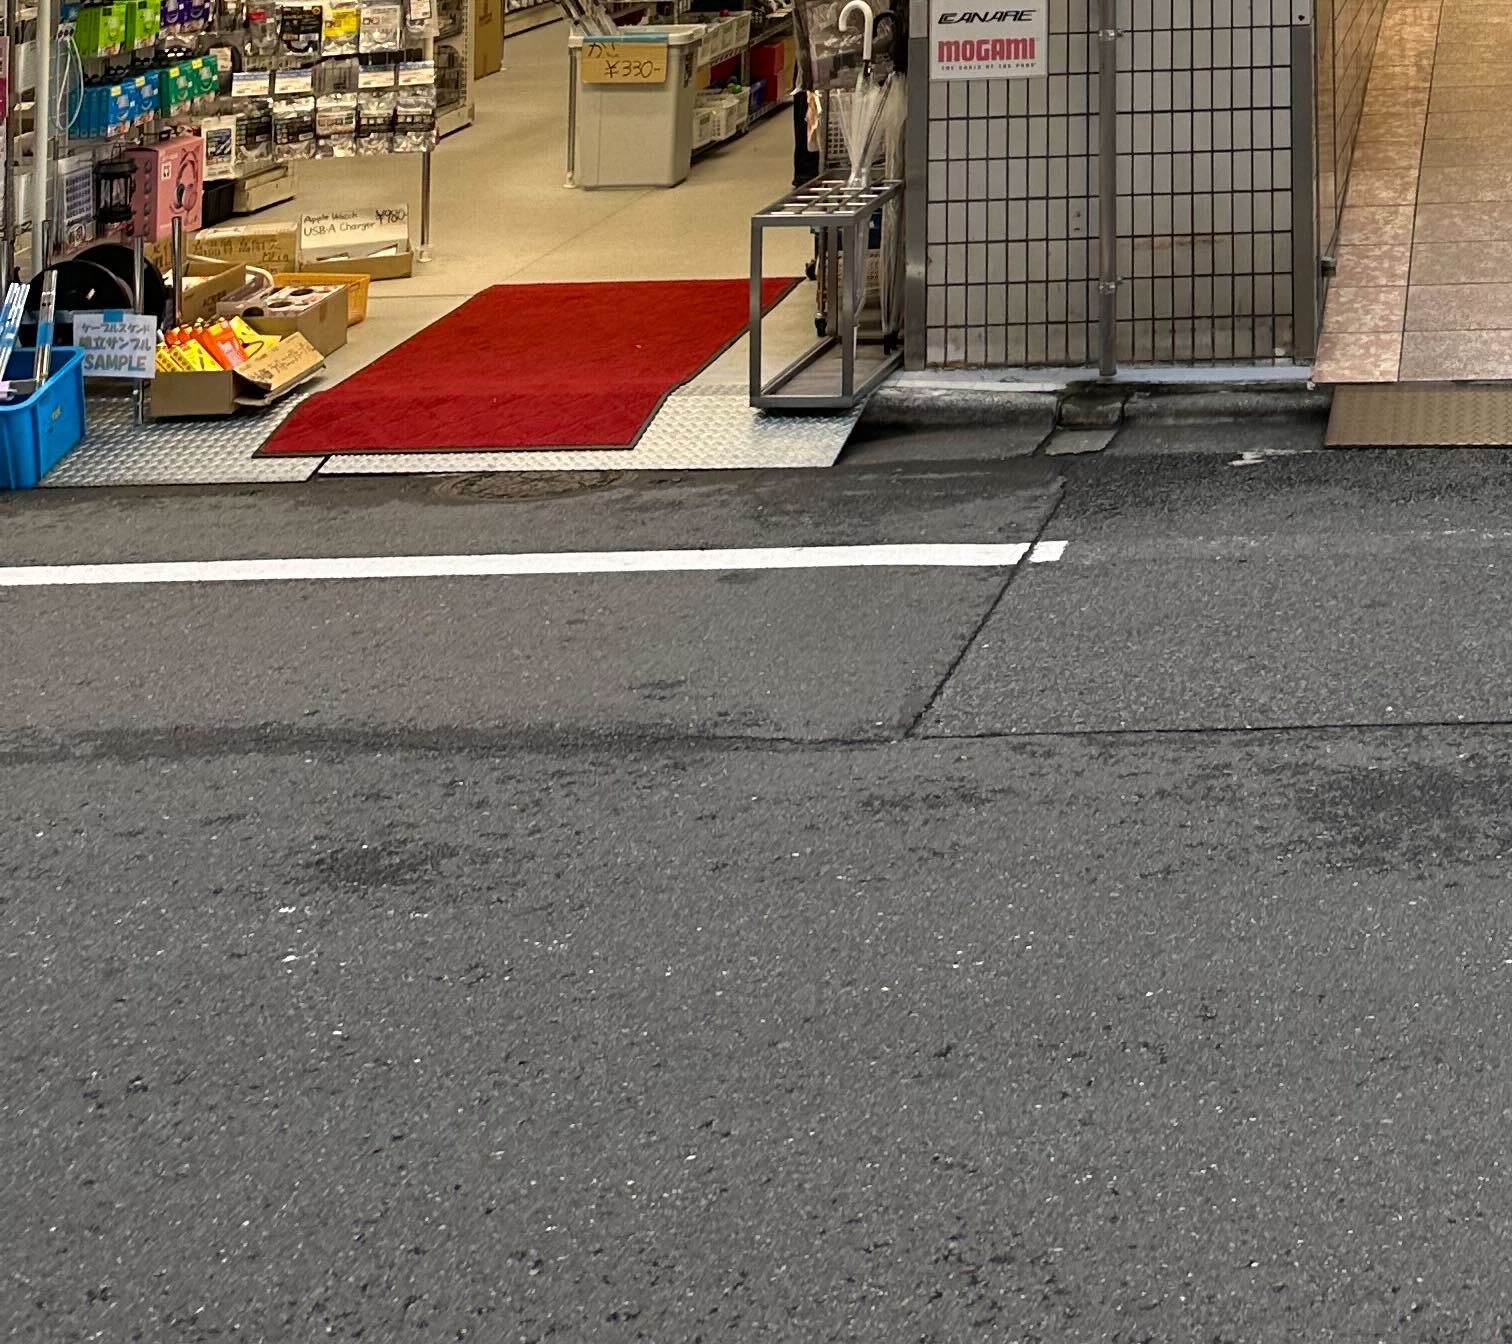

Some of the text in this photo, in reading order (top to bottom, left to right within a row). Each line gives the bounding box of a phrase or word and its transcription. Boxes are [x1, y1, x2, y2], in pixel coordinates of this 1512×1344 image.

[938, 10, 1037, 24] CANARE
[938, 37, 1036, 62] MOGAMI
[304, 212, 330, 224] Apple
[339, 221, 376, 232] Charger
[84, 354, 147, 372] SAMPLE
